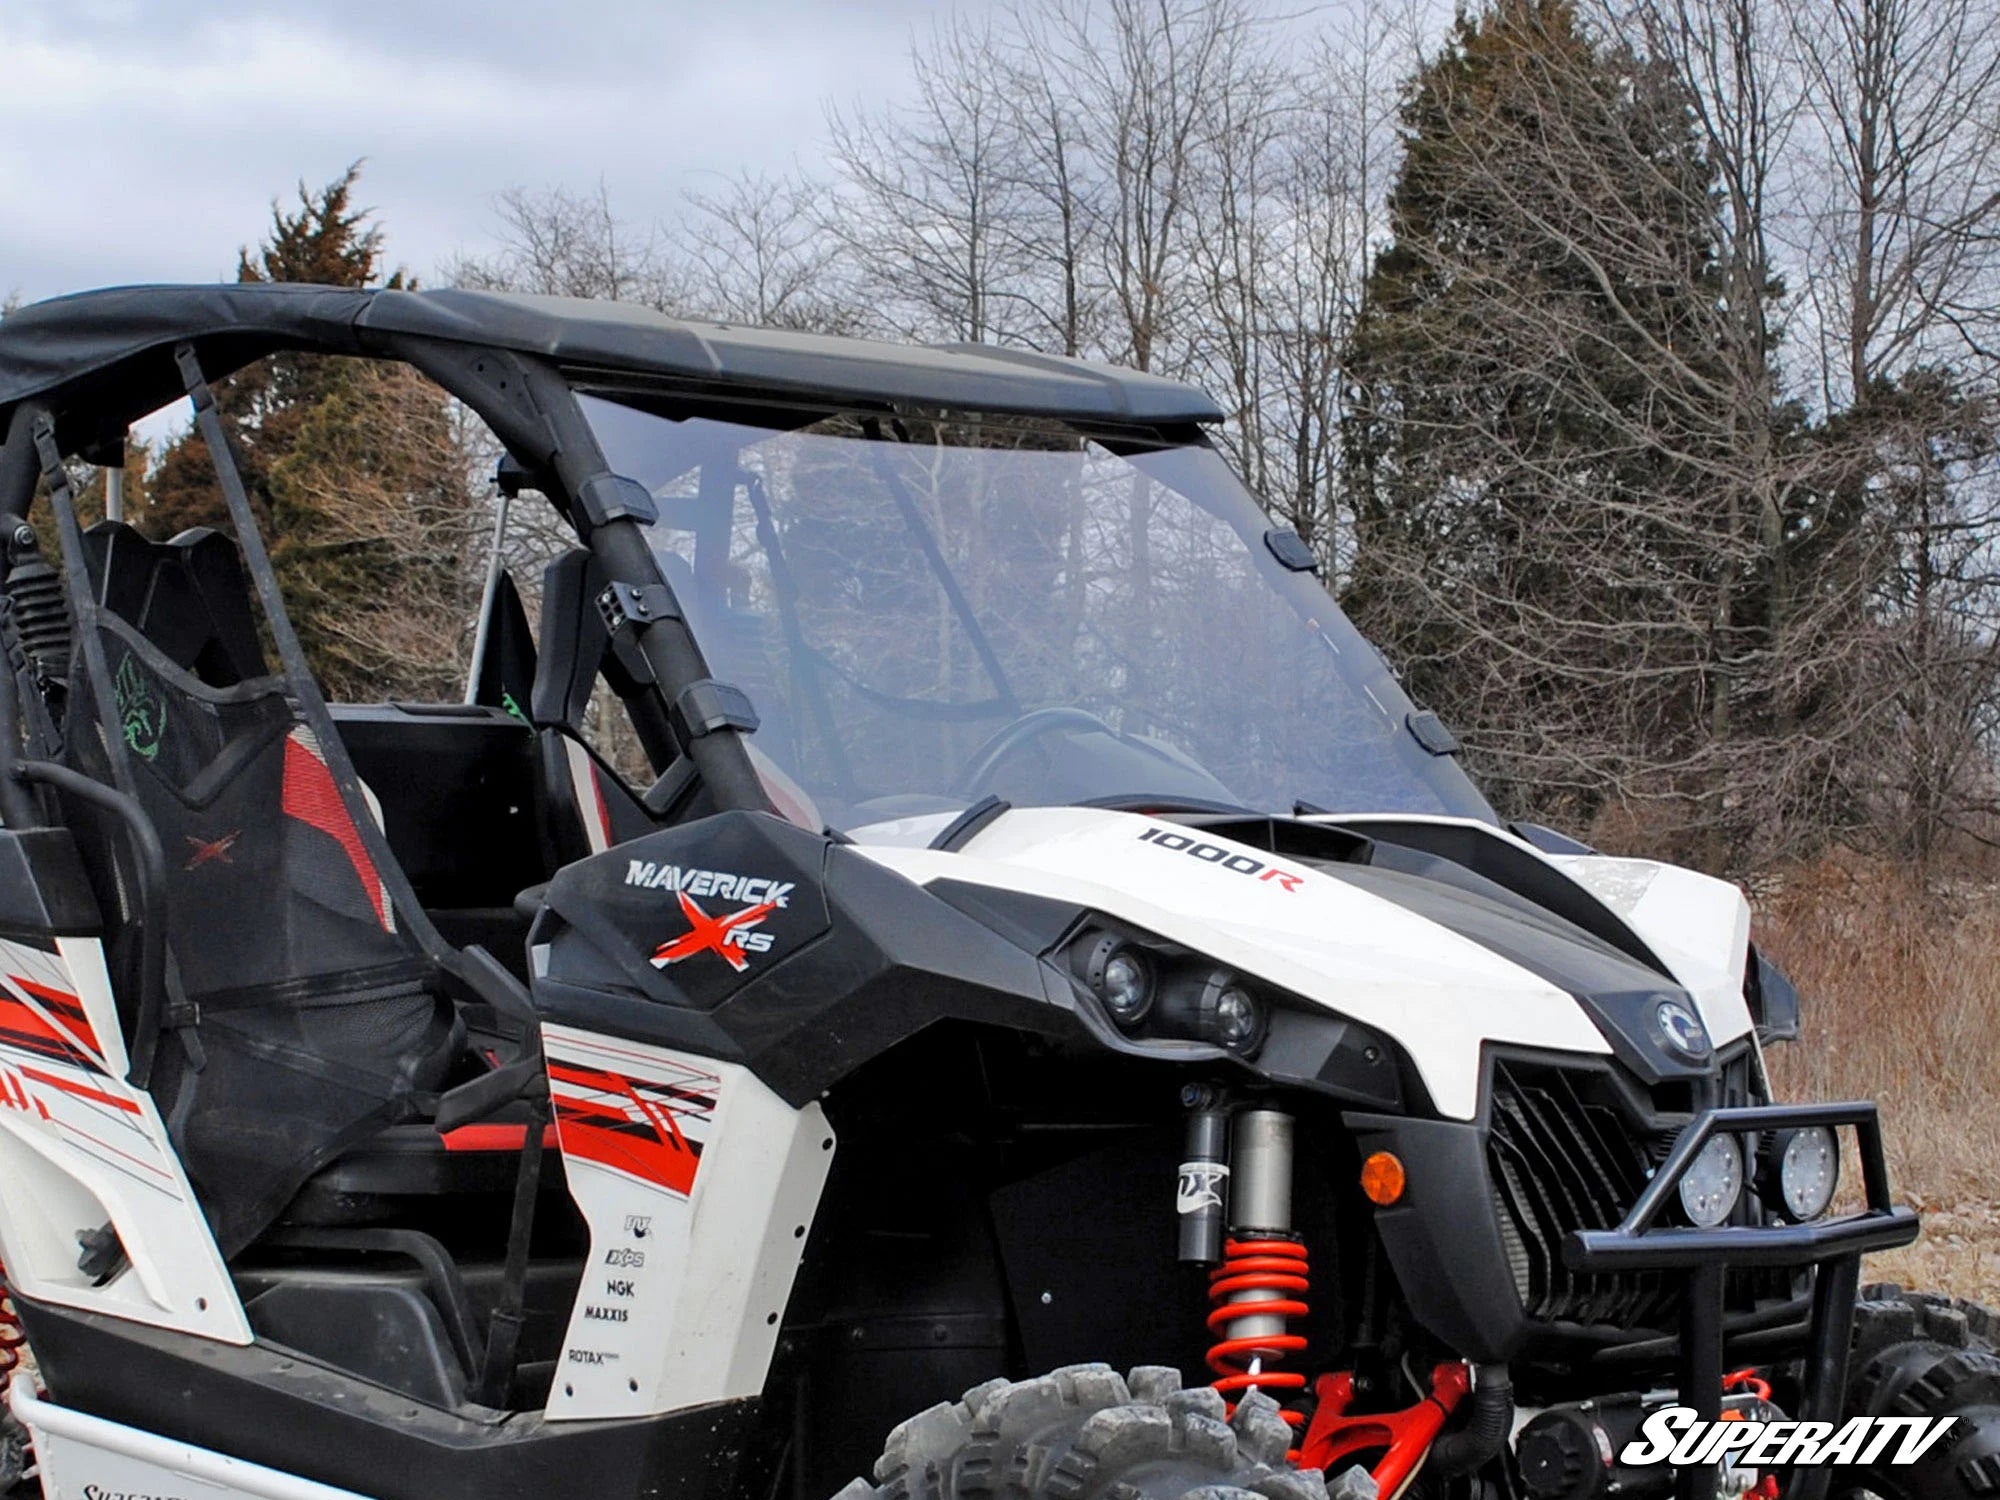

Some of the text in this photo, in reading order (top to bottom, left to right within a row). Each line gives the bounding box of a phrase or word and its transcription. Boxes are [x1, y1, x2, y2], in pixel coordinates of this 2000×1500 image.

[1137, 827, 1304, 893] 1000R
[625, 860, 796, 908] MAVERICK
[606, 1280, 635, 1297] NGK
[584, 1305, 628, 1322] MAXXIS
[569, 1349, 604, 1364] ROTAX
